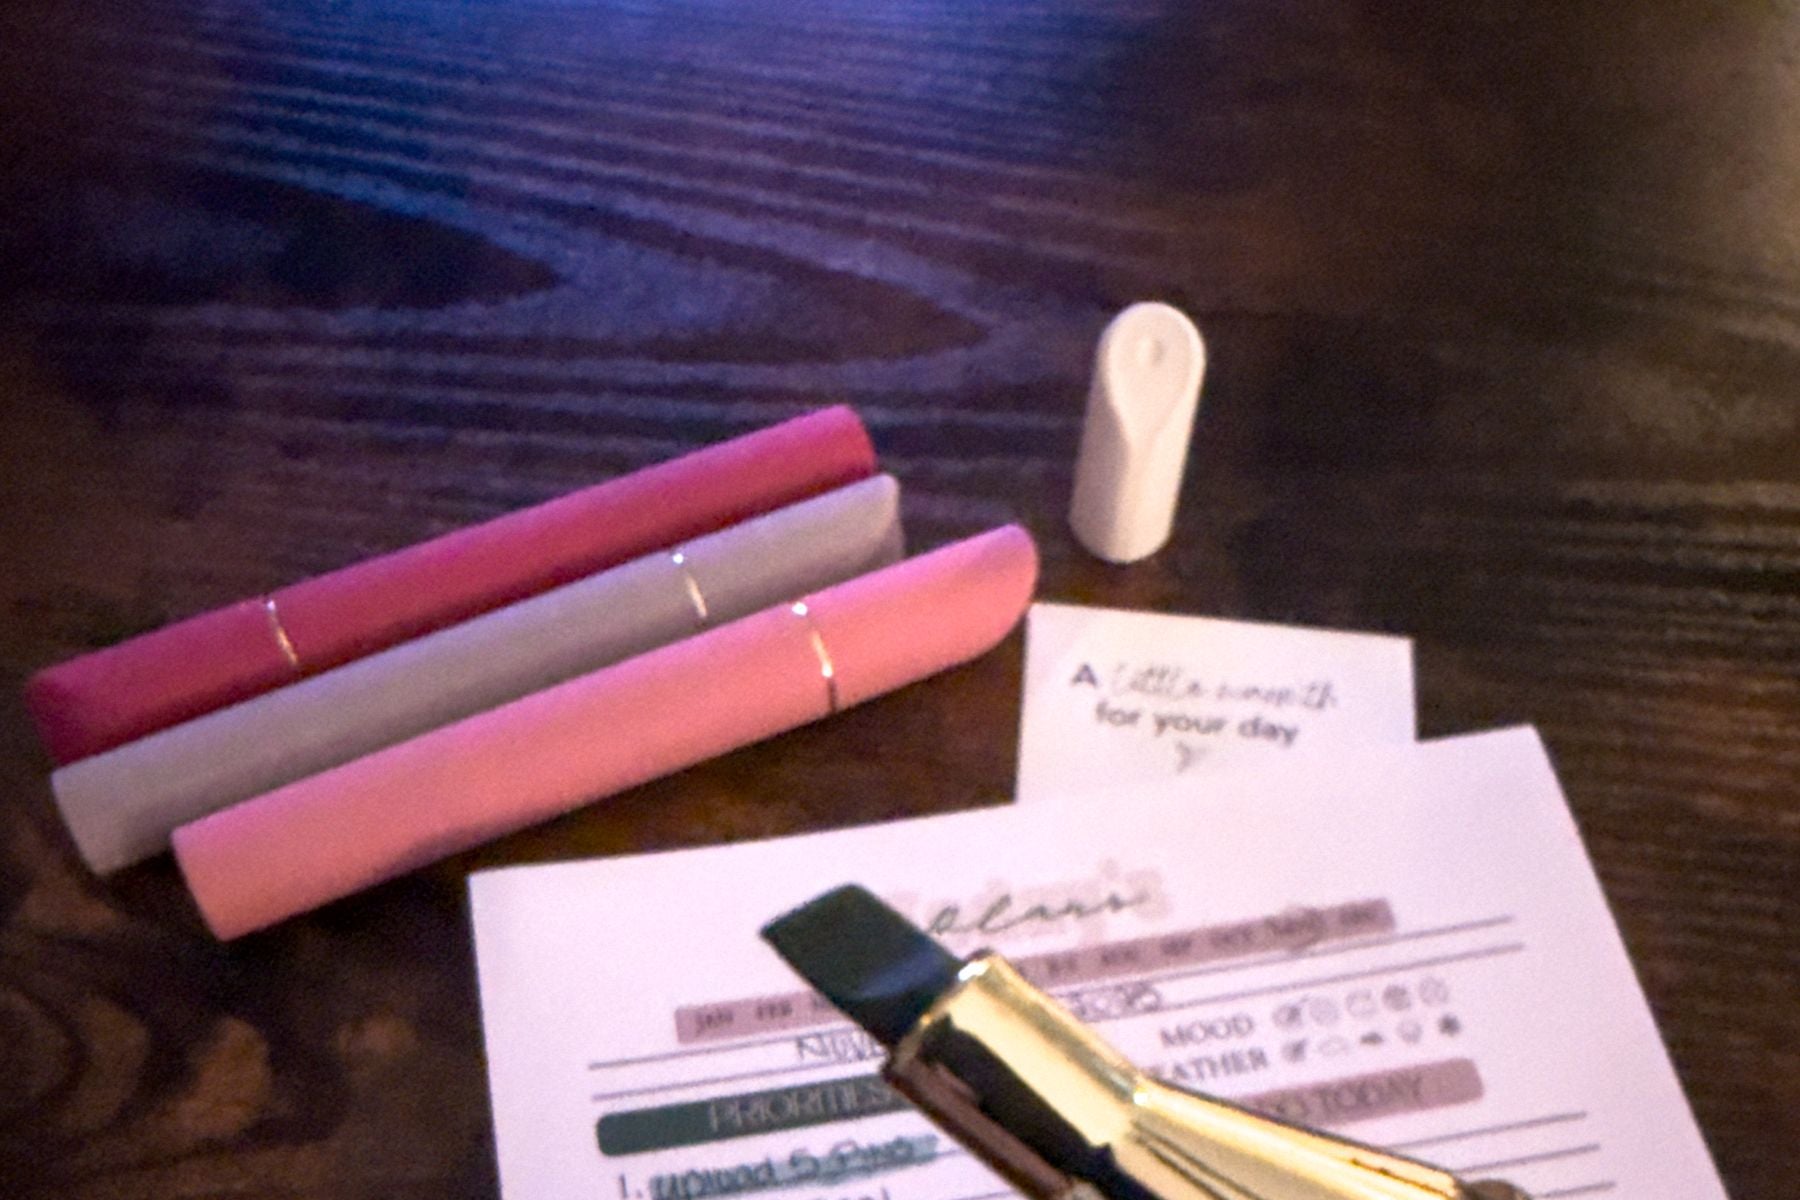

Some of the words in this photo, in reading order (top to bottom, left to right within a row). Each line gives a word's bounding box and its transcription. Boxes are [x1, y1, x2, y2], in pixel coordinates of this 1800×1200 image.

[1071, 662, 1098, 688] A
[1096, 700, 1142, 726] for
[1153, 713, 1228, 738] your
[1237, 717, 1299, 747] day
[1161, 1014, 1255, 1048] MOOD
